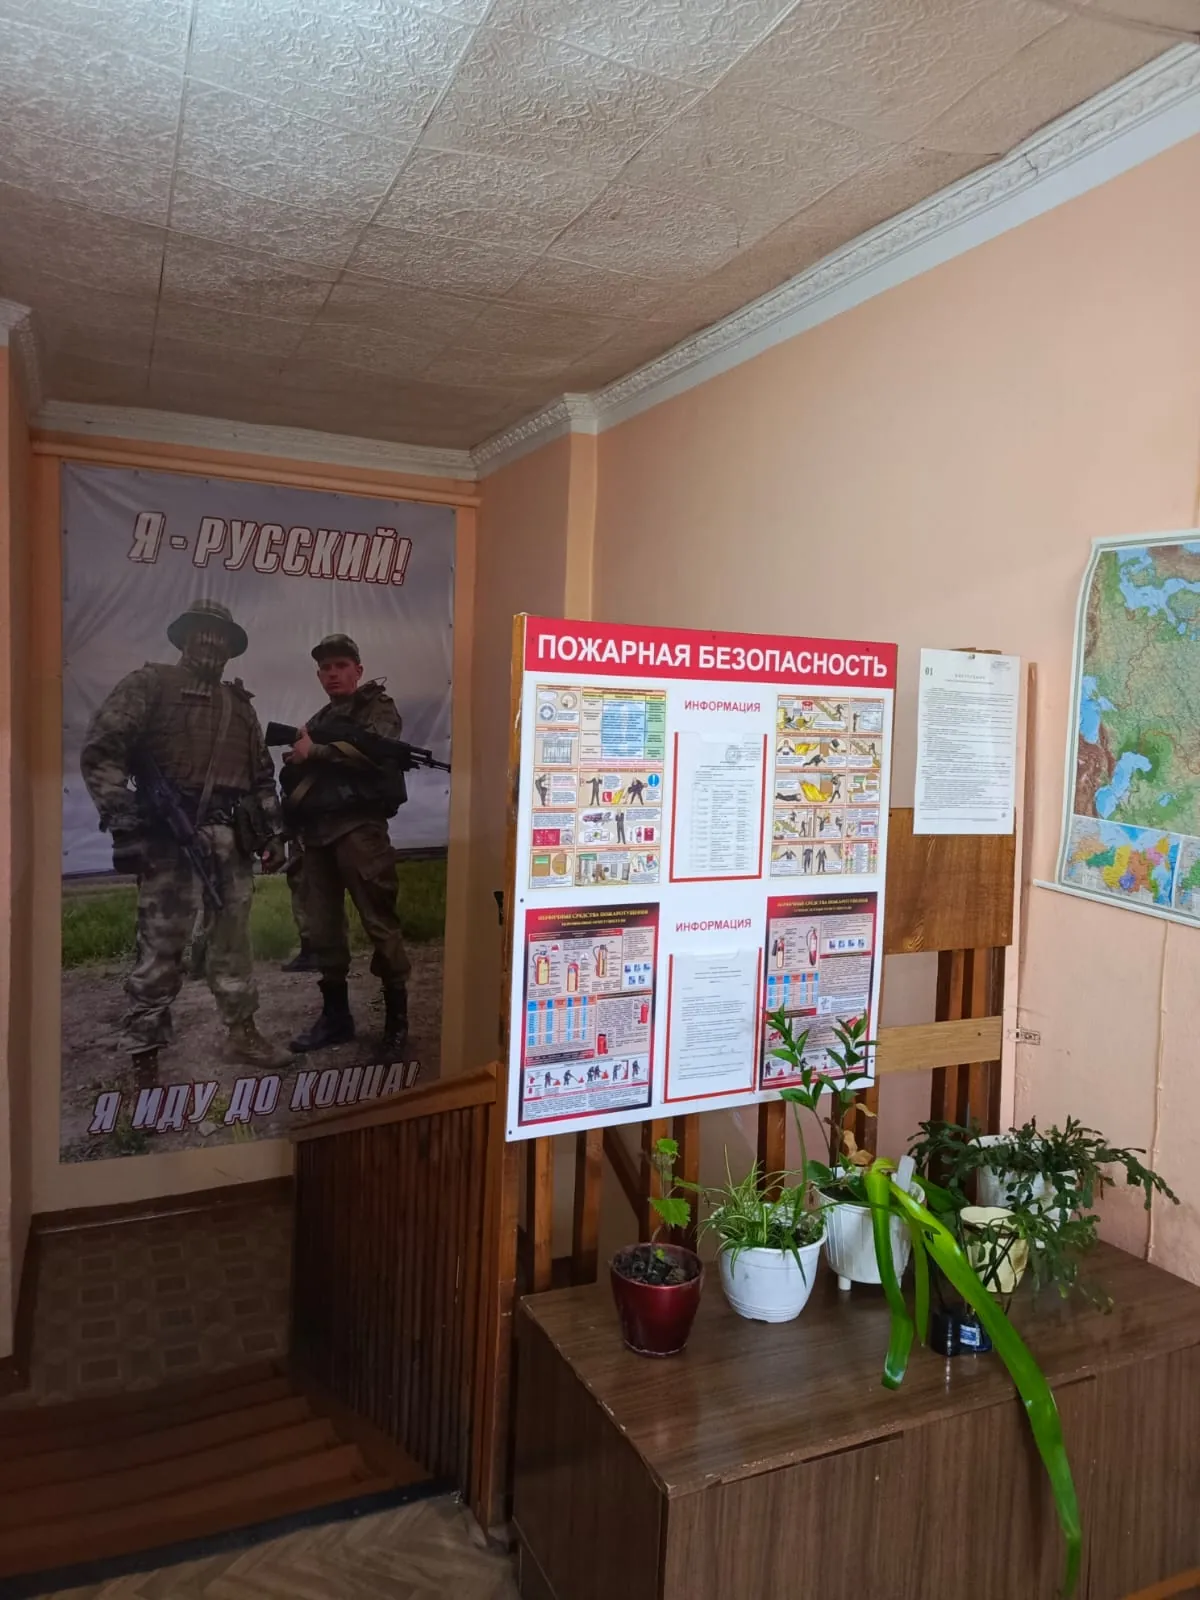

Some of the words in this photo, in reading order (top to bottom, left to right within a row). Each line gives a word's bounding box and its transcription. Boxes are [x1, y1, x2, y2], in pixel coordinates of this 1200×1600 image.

[128, 511, 166, 565] Я
[193, 516, 412, 586] РУССКИЙ!
[537, 633, 691, 668] ПОЖАРНАЯ
[698, 645, 888, 678] БЕЗОПАСНОСТЬ
[684, 699, 761, 713] ИНФОРМАЦИЯ
[675, 918, 752, 932] ИНФОРМАЦИЯ
[87, 1091, 122, 1135] Я
[132, 1080, 218, 1134] ИДУ
[224, 1074, 283, 1126] ДО
[290, 1060, 421, 1112] КОНЦА!
